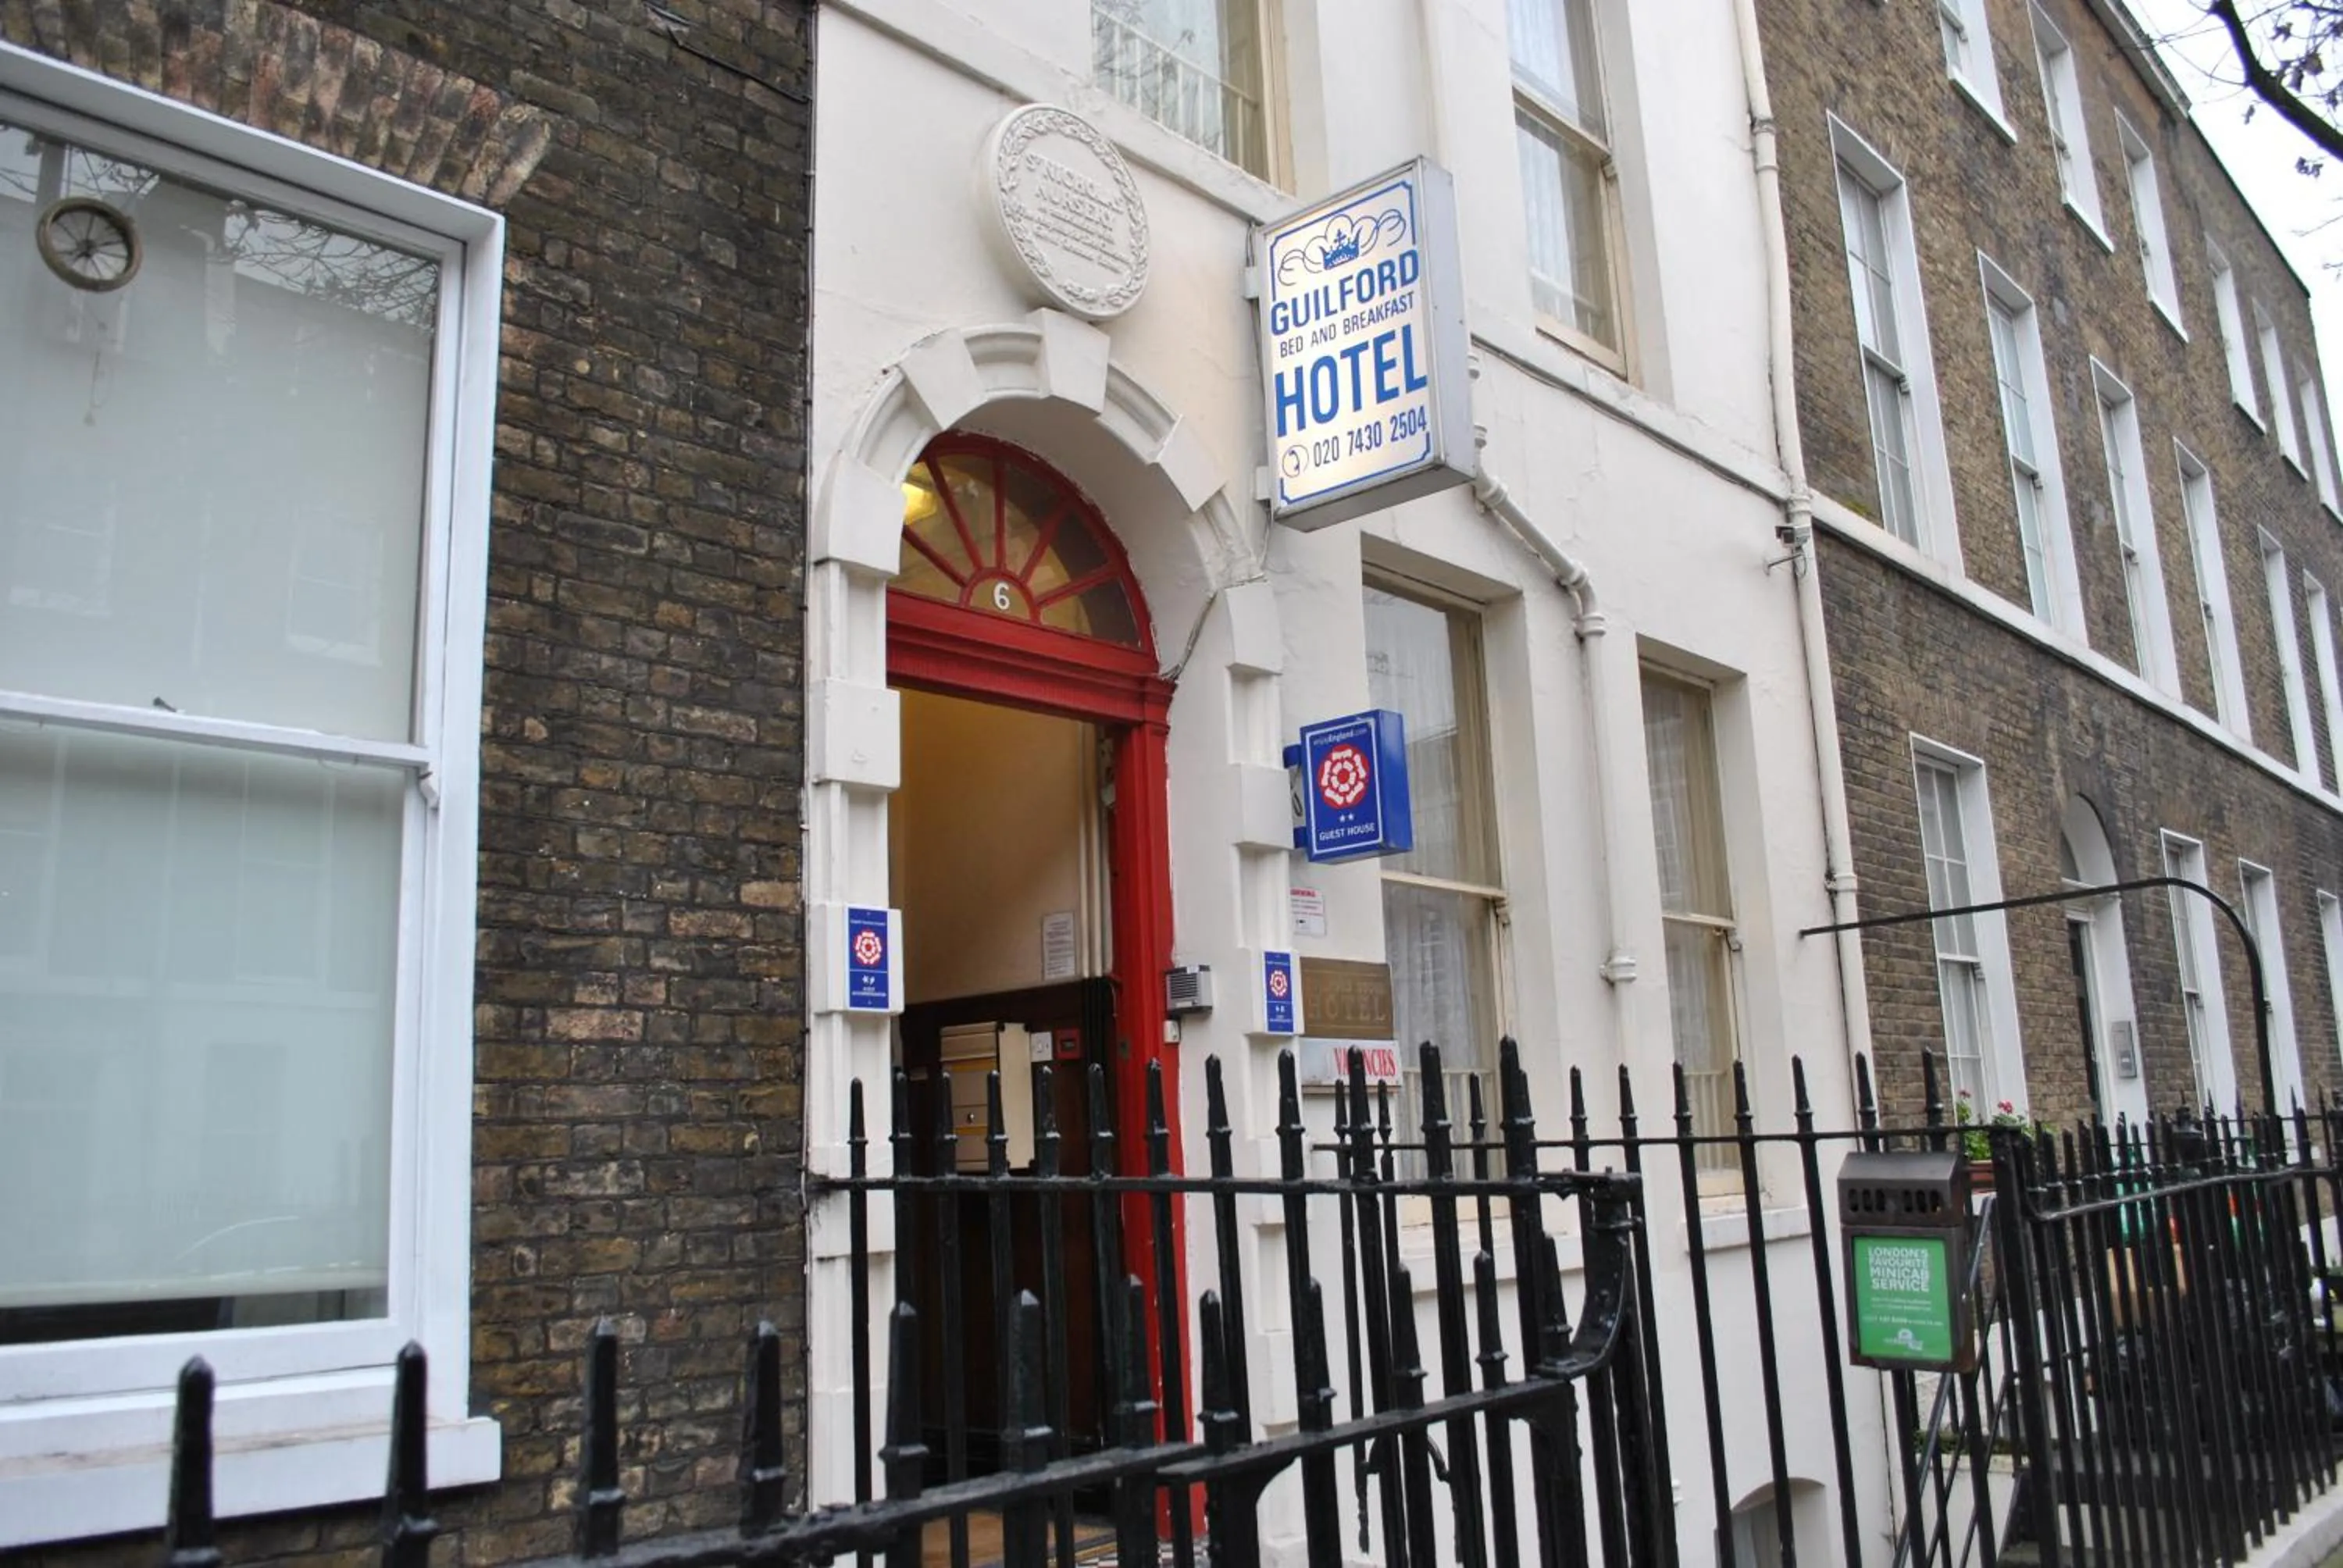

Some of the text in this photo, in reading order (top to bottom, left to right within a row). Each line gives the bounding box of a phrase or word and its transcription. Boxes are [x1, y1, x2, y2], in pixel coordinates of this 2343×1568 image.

[1271, 249, 1420, 336] GUILFORD
[1279, 291, 1415, 358] BED AND BREAKFAST
[1274, 323, 1428, 438] HOTEL
[1313, 405, 1428, 469] 020 7430 2504
[993, 582, 1011, 610] 6
[1319, 822, 1375, 841] GUEST HOUSE
[1333, 1047, 1396, 1075] VANCIES
[1870, 1267, 1929, 1281] MINICAB
[1872, 1278, 1929, 1292] SERVICE
